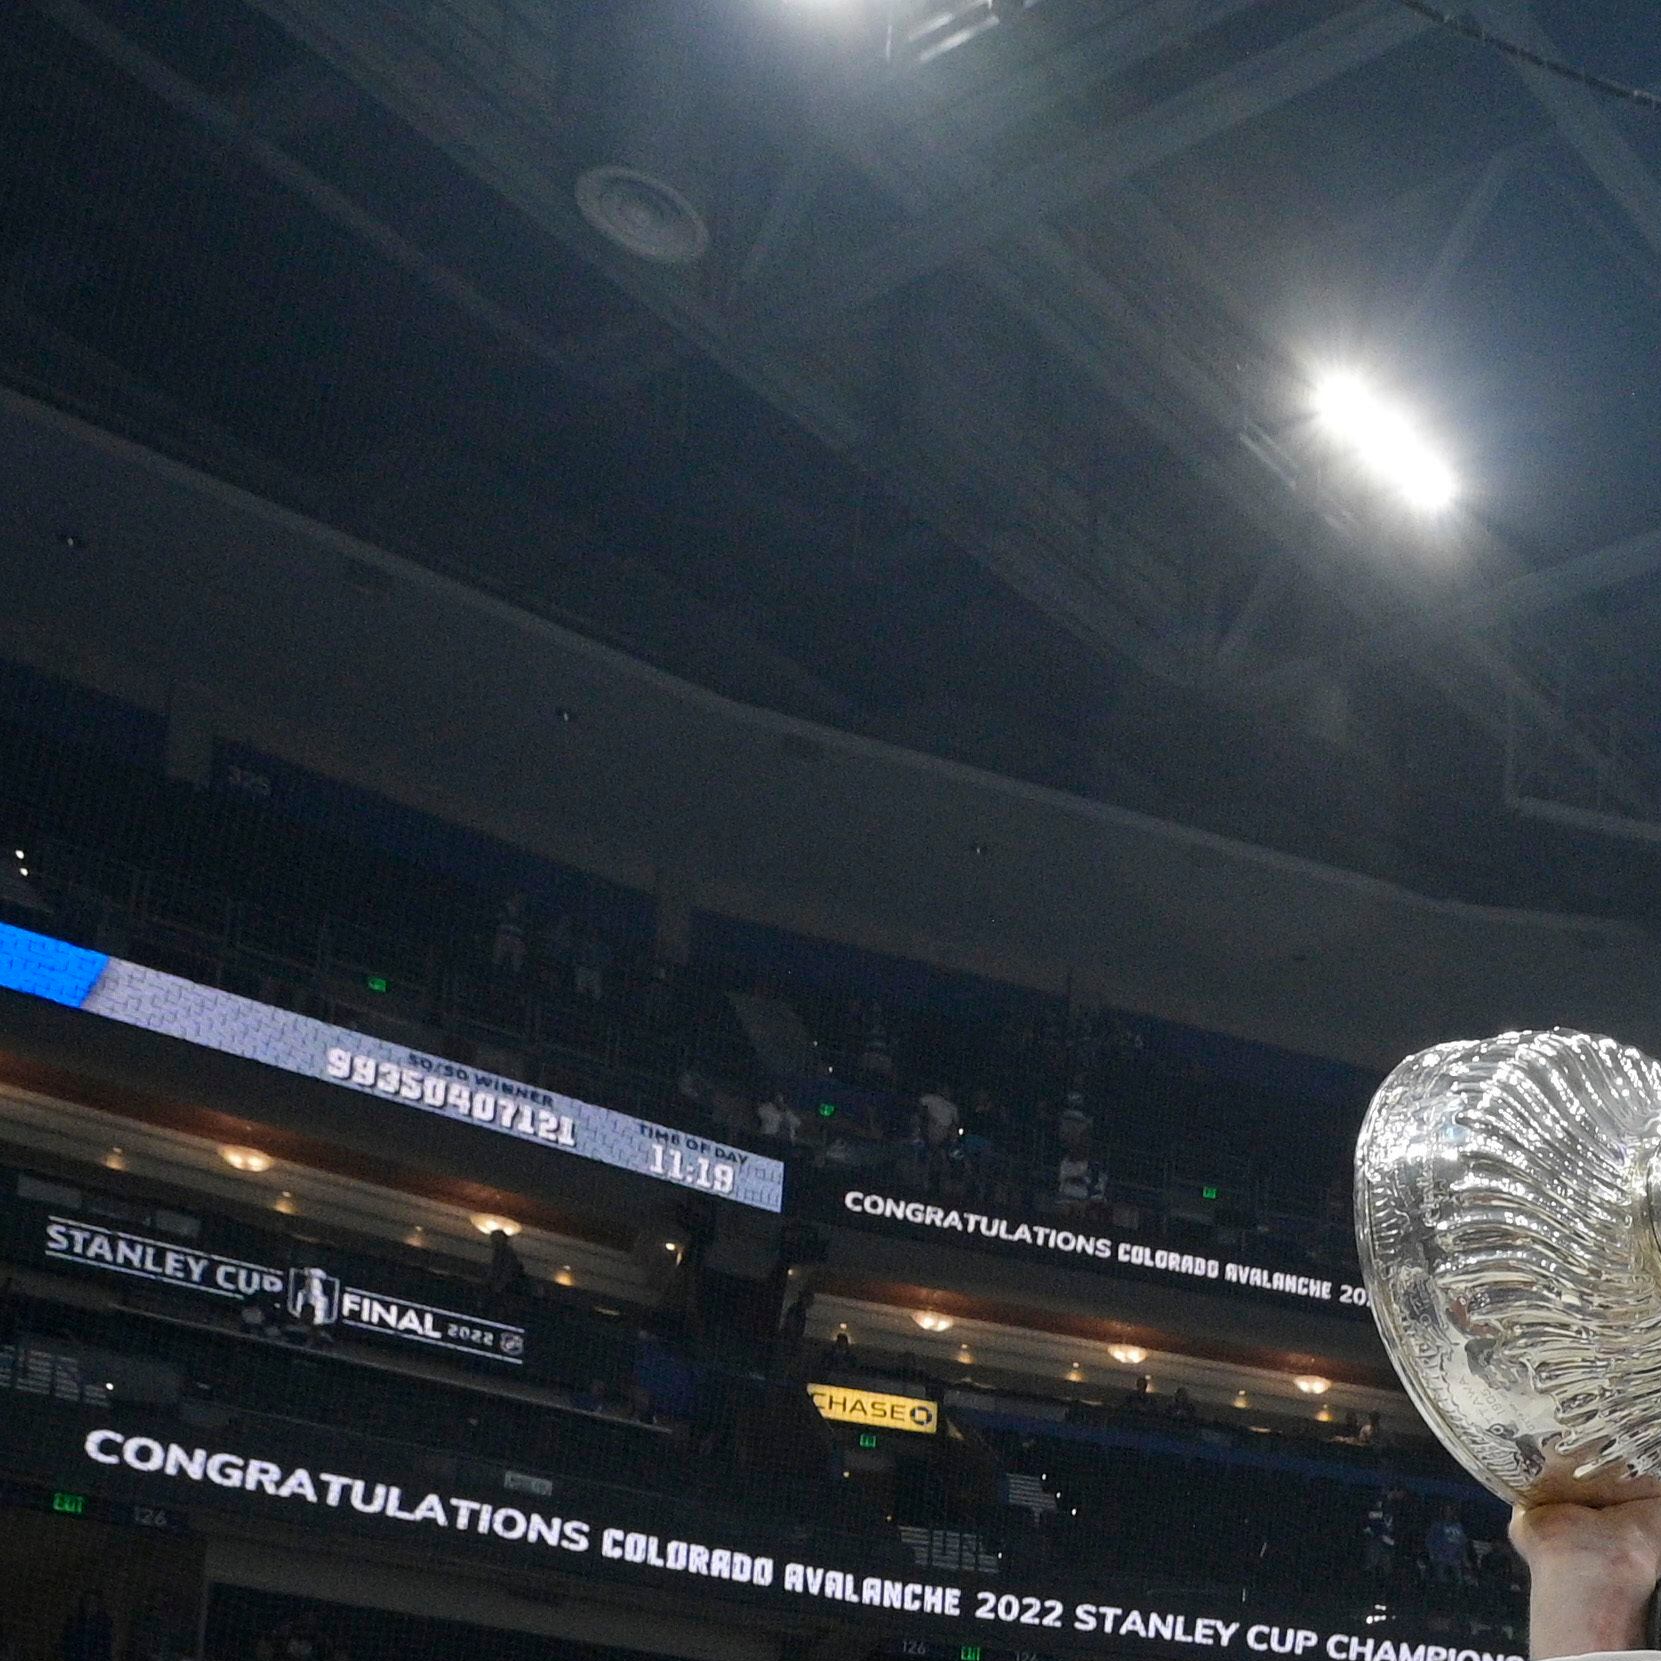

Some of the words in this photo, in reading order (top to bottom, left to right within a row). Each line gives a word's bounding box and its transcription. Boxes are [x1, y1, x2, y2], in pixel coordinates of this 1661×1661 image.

[474, 1073, 554, 1106] WINNER
[638, 1123, 682, 1146] TIME
[685, 1136, 707, 1153] OF
[714, 1144, 749, 1166] DAY
[649, 1142, 736, 1194] 11:19
[46, 1224, 209, 1284] STANLEY
[217, 1263, 284, 1295] CUP
[845, 1192, 1111, 1258] CONGRATULATIONS
[1118, 1243, 1219, 1278] COLORADO
[1225, 1263, 1331, 1299] AVALANCHE
[1340, 1283, 1373, 1306] 20
[342, 1292, 442, 1339] FINAL
[447, 1323, 493, 1347] 2022
[85, 1430, 589, 1551] CONGRATULATIONS
[602, 1528, 773, 1586] COLORADO
[785, 1563, 961, 1616] AVALANCHE
[975, 1592, 1063, 1627] 2022
[1074, 1604, 1239, 1646] STANLEY
[1247, 1625, 1318, 1654] CUP
